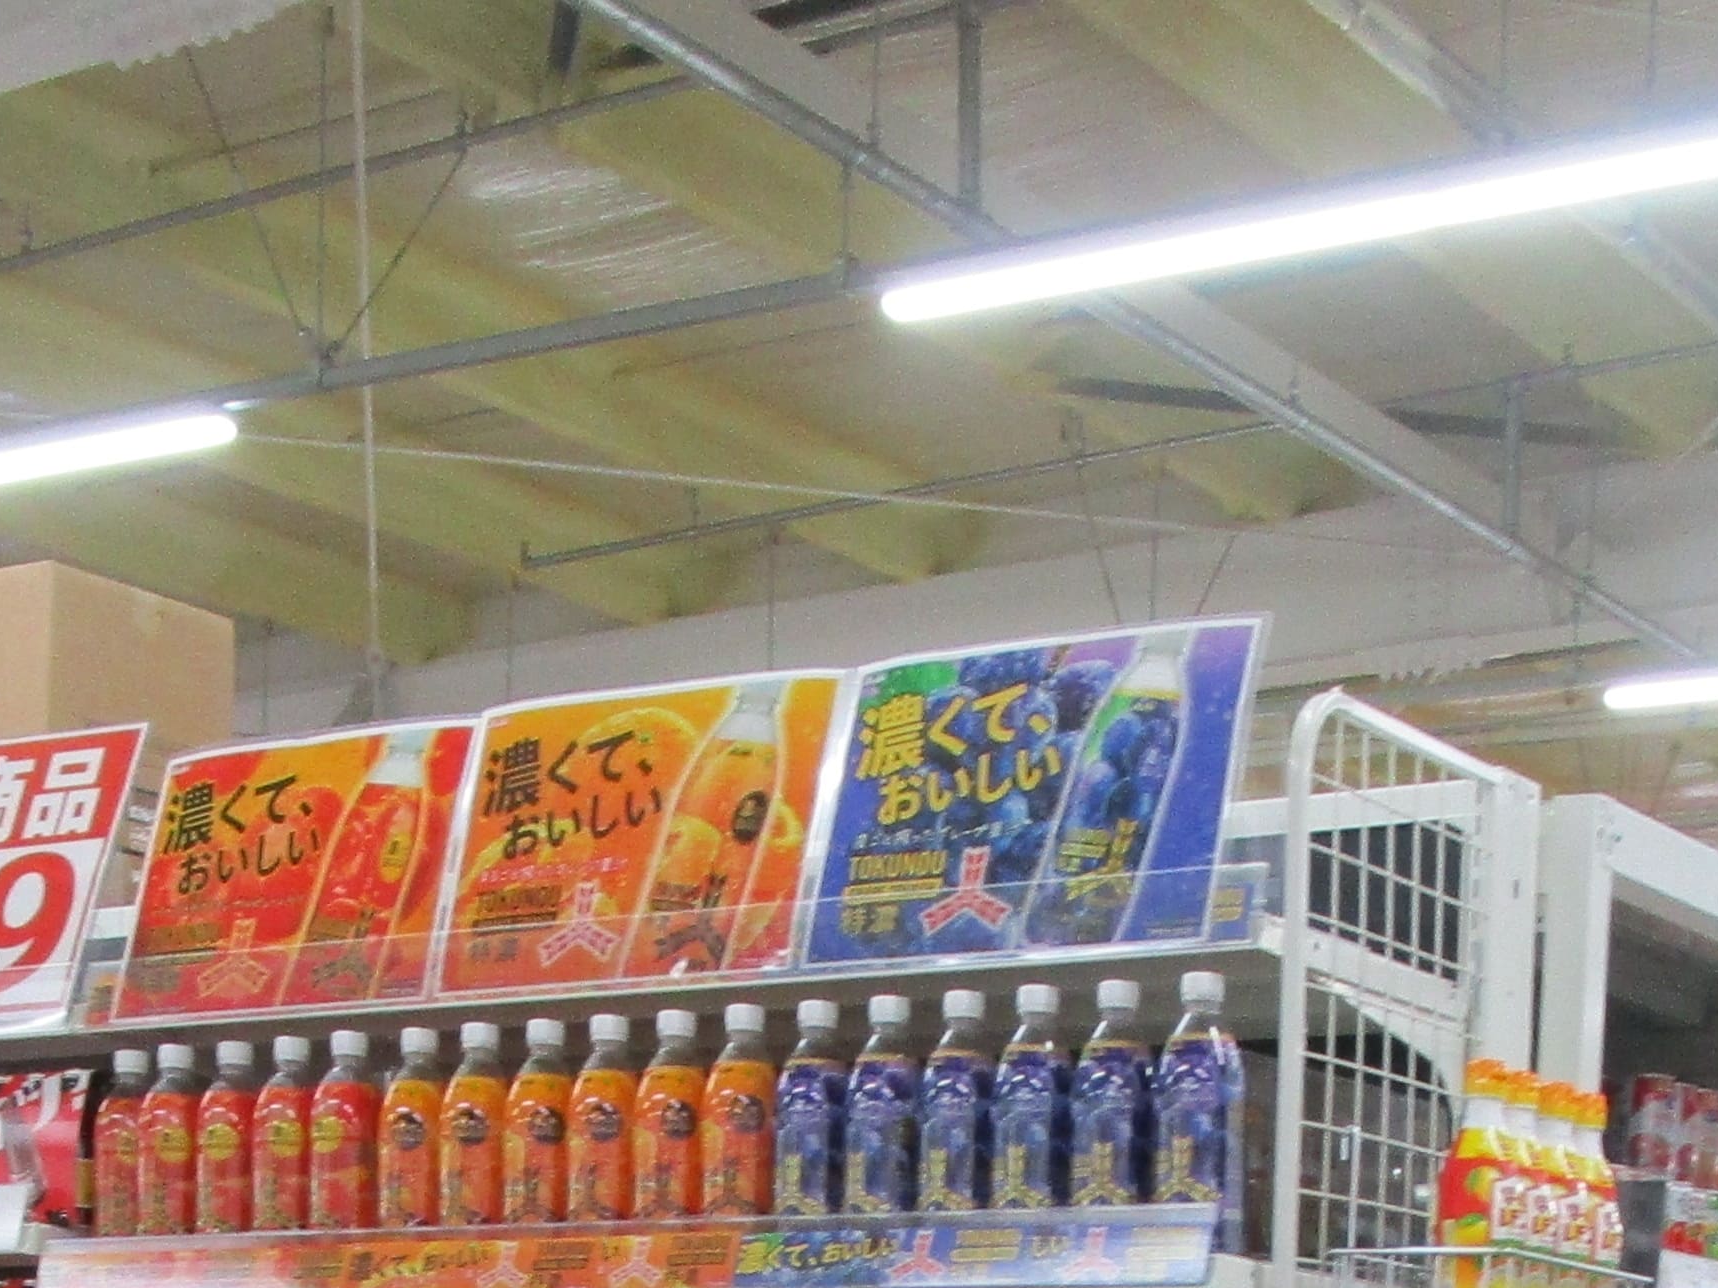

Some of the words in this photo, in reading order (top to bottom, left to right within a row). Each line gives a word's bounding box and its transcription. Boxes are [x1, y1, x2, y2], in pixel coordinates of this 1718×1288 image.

[502, 786, 662, 860] おいしい
[876, 746, 1063, 827] おいしい
[178, 828, 320, 896] おいしい
